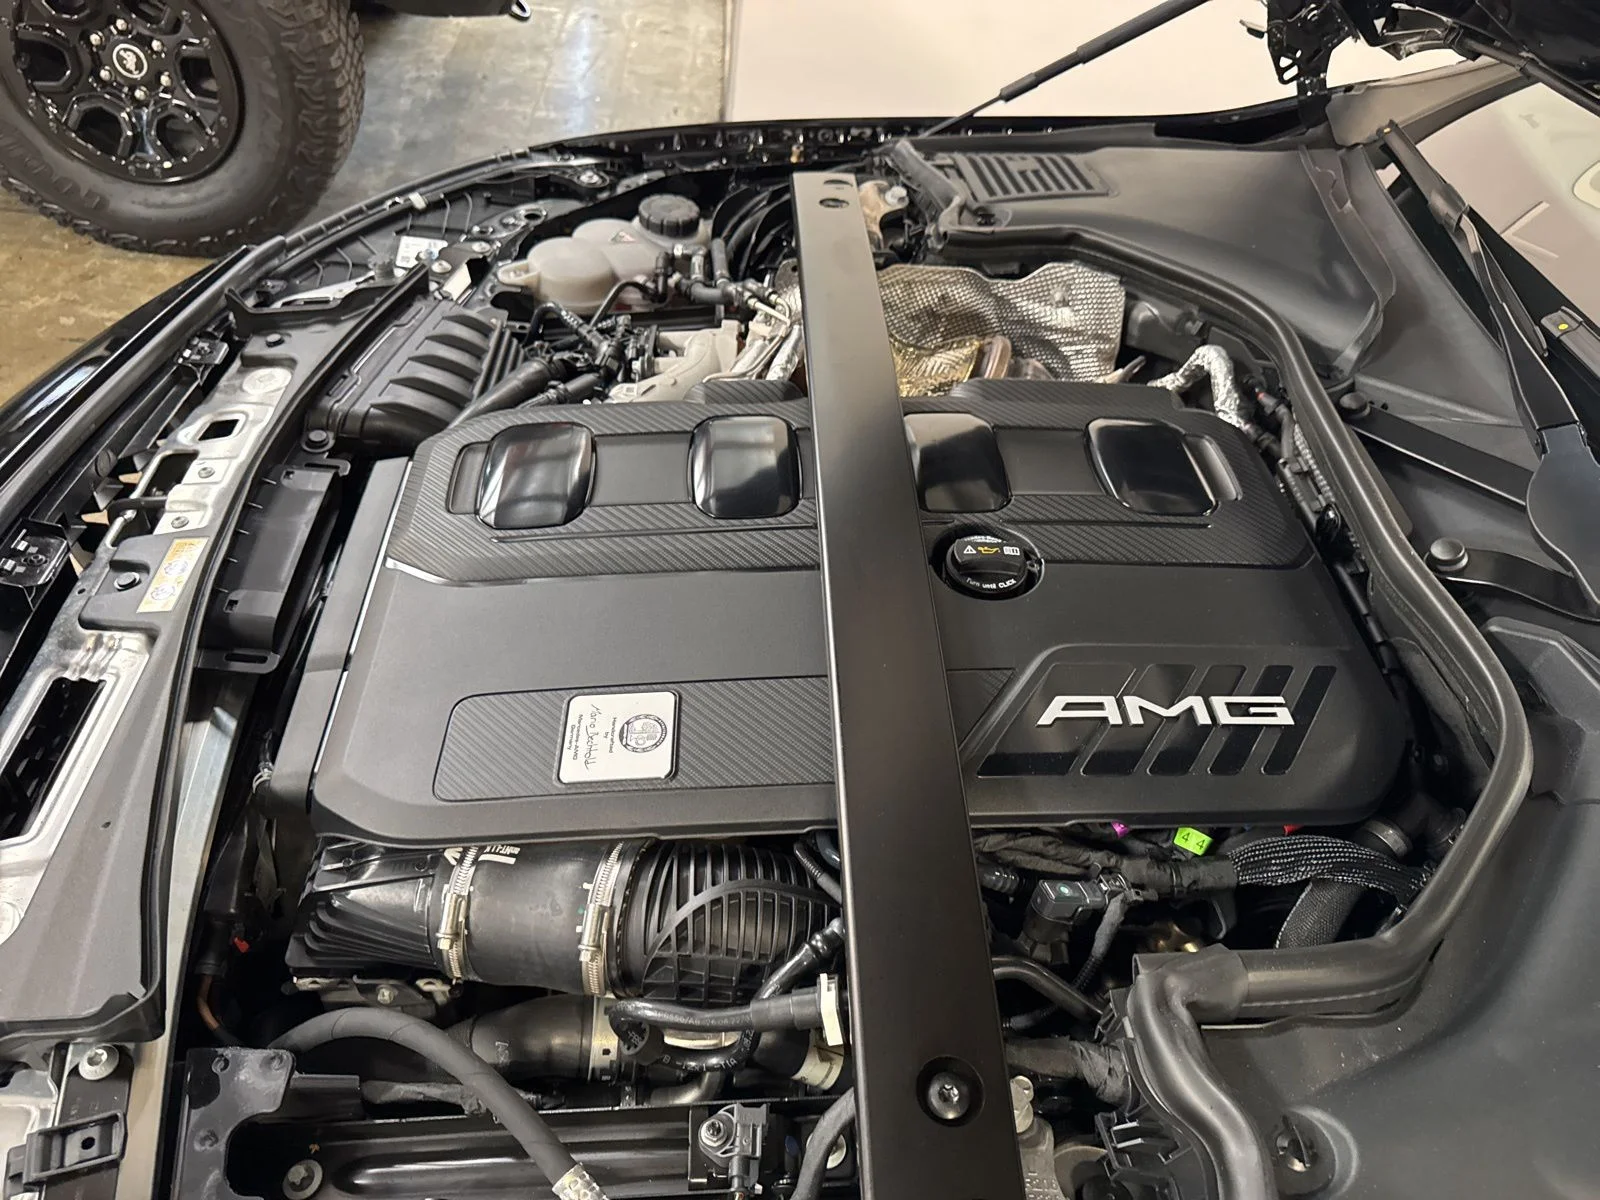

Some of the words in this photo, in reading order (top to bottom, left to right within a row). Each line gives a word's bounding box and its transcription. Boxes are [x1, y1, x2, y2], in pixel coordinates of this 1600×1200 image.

[1035, 695, 1295, 727] AMG
[567, 724, 576, 750] Germany
[572, 714, 584, 761] Mercedes-AMG
[603, 731, 610, 739] by
[609, 717, 617, 753] Handcrafted
